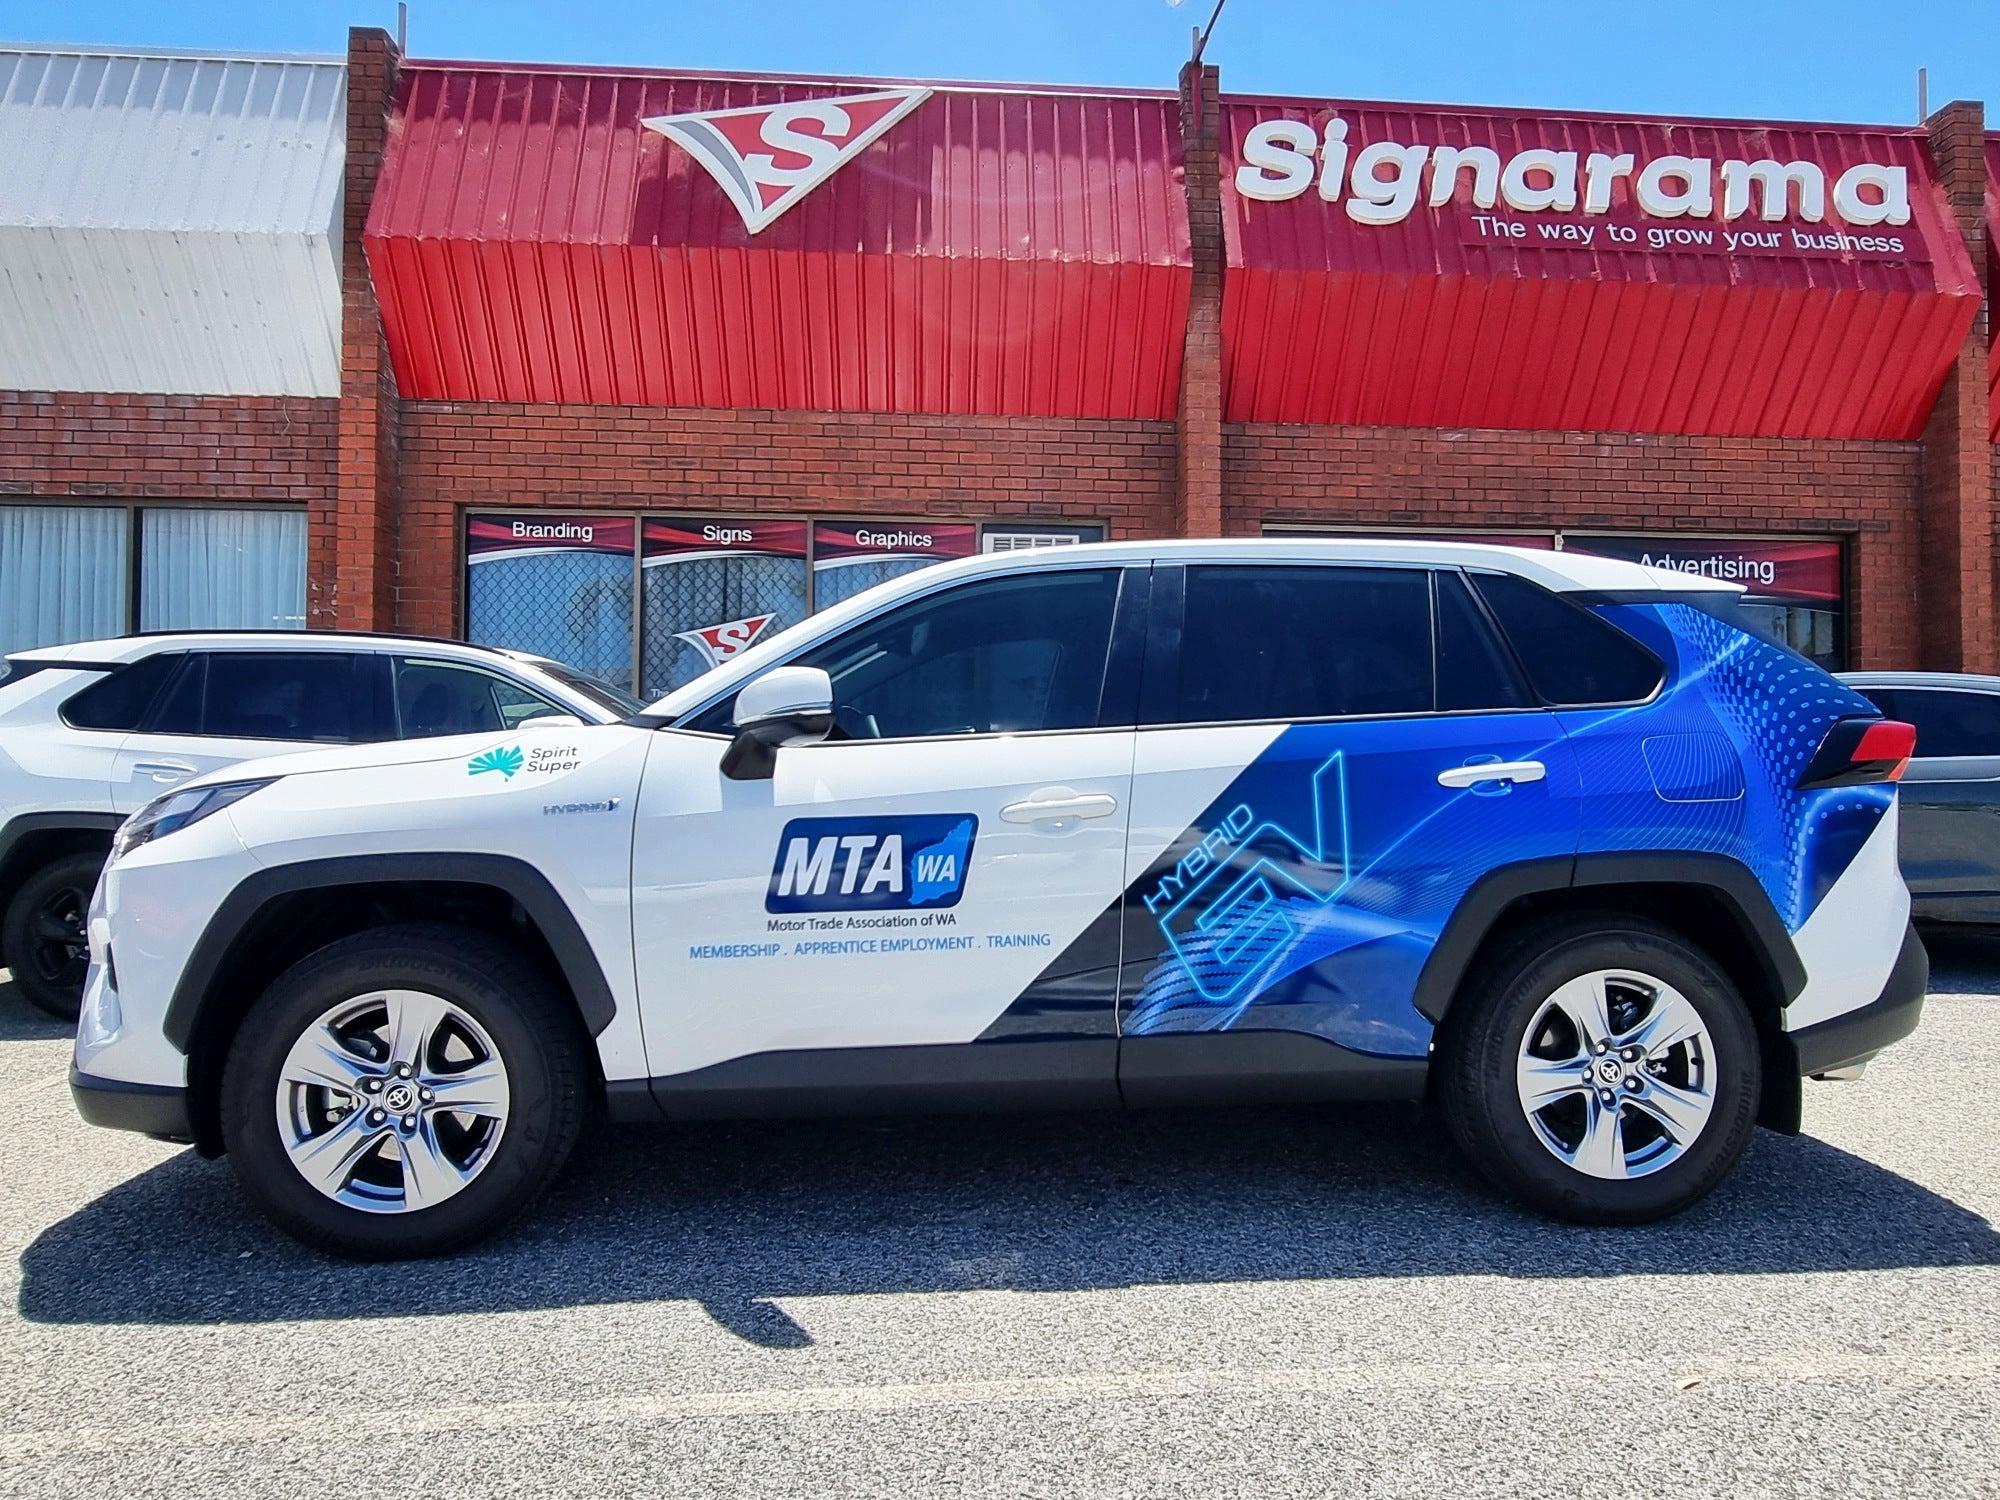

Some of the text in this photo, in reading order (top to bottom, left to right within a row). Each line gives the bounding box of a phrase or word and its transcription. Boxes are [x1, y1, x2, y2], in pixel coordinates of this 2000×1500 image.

[1234, 117, 1912, 226] Signarama
[1471, 215, 1905, 253] The way to grow your business
[512, 522, 593, 542] Branding
[703, 525, 753, 546] Signs
[855, 531, 933, 549] Graphics
[531, 746, 578, 761] Spirit
[527, 760, 581, 774] Super
[777, 834, 956, 897] MTA WA
[1143, 804, 1253, 915] HYBRID
[767, 913, 957, 932] Motor Trade Association of WA
[689, 943, 780, 959] MEMBERSHIP
[794, 940, 877, 956] APPRENTICE
[881, 936, 975, 952] EMPLOYMENT
[986, 934, 1051, 949] TRAINING
